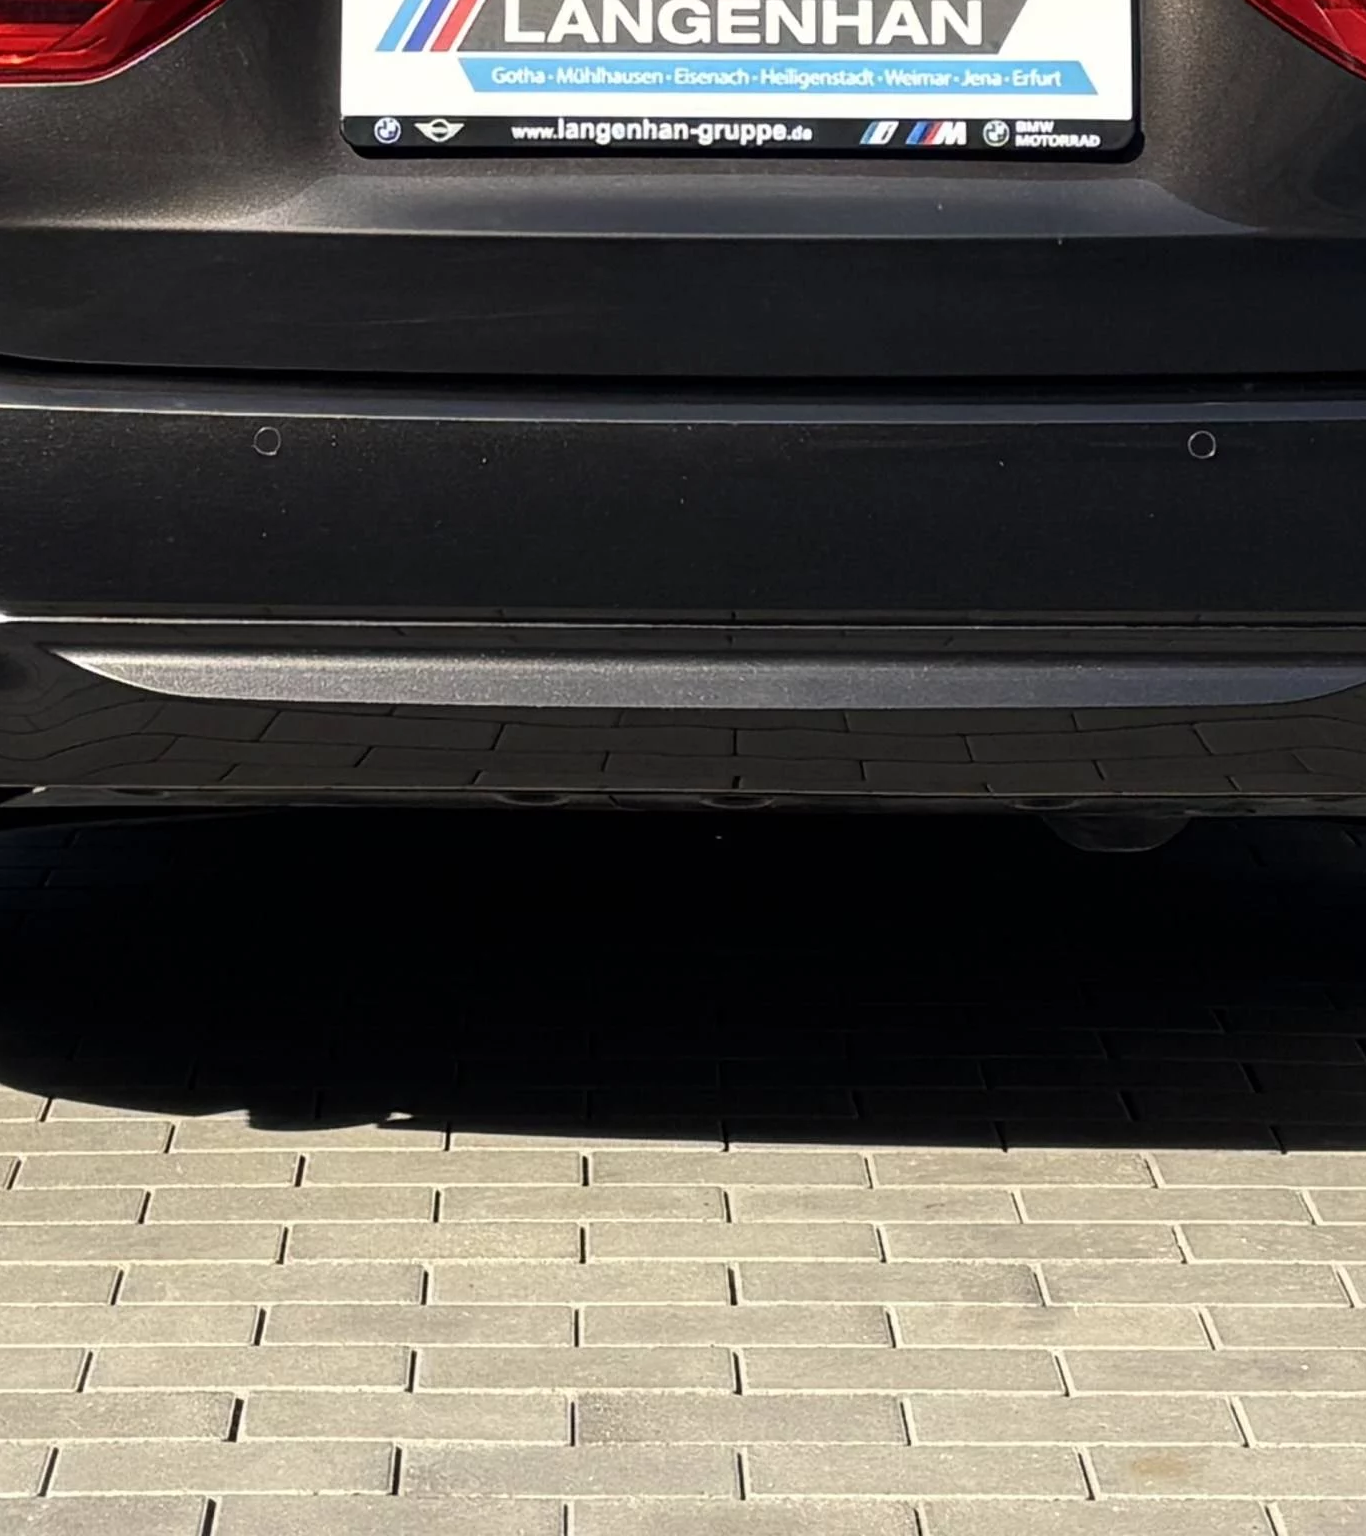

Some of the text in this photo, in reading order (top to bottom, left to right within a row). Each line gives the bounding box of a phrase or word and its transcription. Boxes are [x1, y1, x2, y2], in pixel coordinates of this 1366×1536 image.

[491, 66, 1062, 90] Gotha Mühlhausen Eisenach Heiligenstadt Weimar Jena Erfurt
[511, 117, 813, 145] www.langenhan-gruppe.de
[1015, 120, 1054, 133] BMW
[1015, 135, 1101, 147] MOTORRAD
